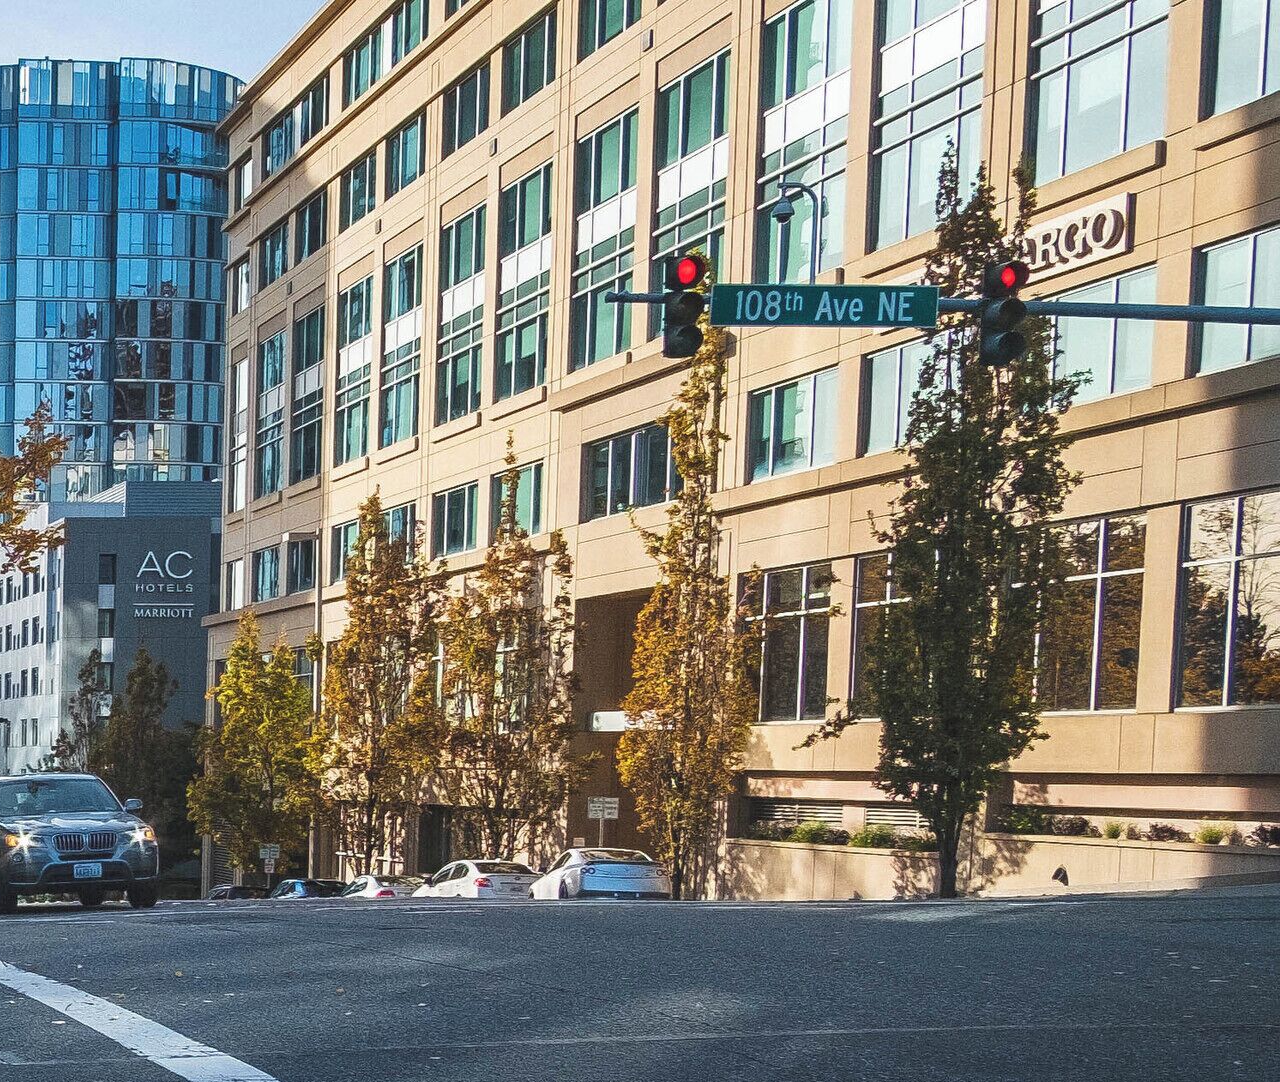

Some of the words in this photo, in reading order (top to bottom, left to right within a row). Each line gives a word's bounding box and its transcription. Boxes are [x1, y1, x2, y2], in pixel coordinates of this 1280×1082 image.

[1022, 208, 1126, 273] RGO
[736, 290, 803, 321] 108th
[814, 291, 864, 322] Ave
[878, 291, 915, 322] NE
[136, 551, 193, 579] AC
[135, 583, 194, 593] HOTELS
[133, 608, 194, 618] MARRIOTT
